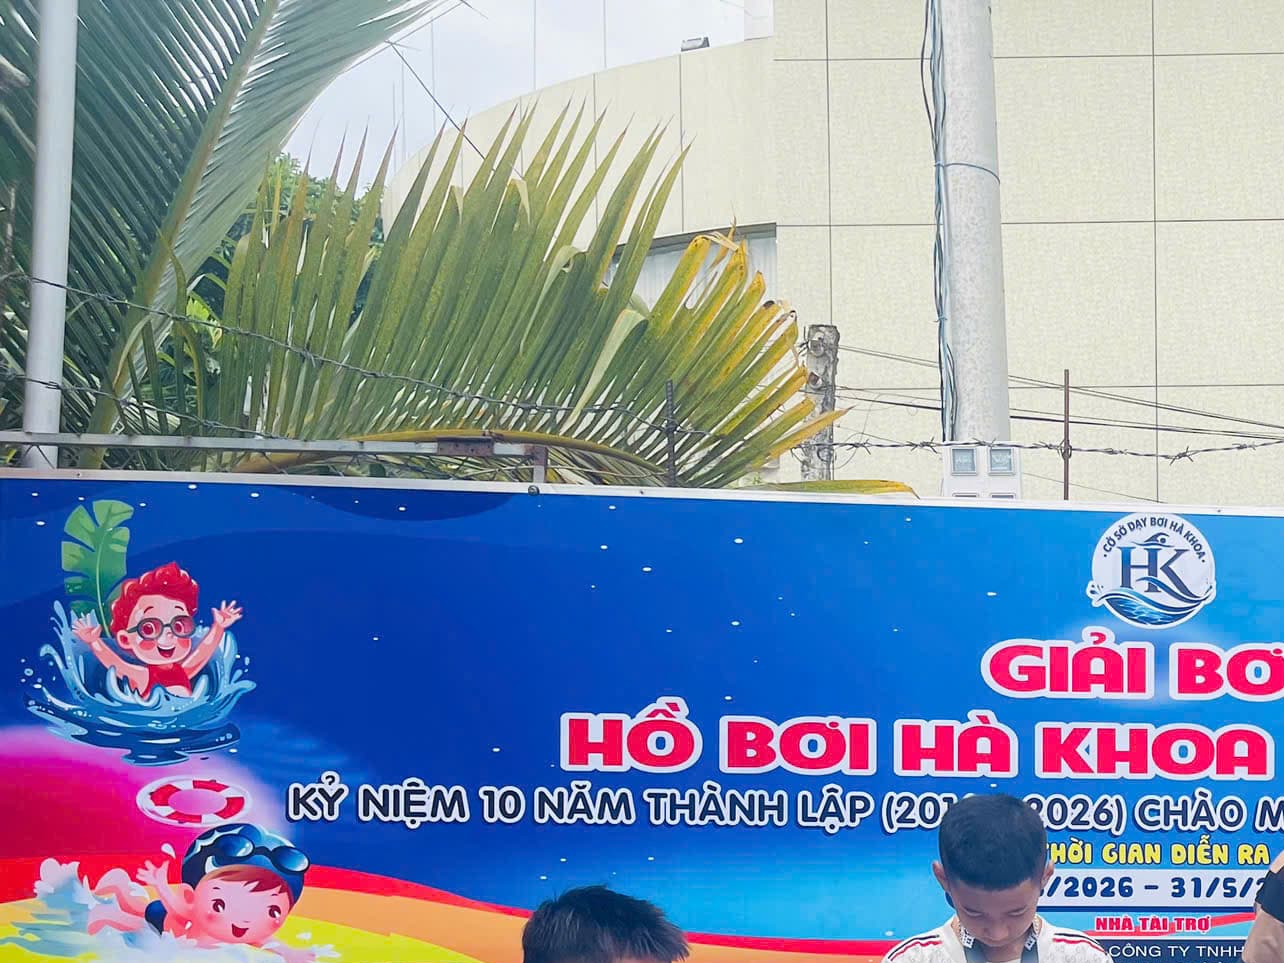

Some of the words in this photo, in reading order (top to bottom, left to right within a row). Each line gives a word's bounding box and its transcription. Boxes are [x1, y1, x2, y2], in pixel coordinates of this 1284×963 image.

[1127, 517, 1147, 531] DẠY
[1150, 517, 1168, 528] BƠI
[1183, 530, 1206, 559] KHOA
[986, 630, 1149, 695] GIẢI
[566, 700, 697, 769] HỒ
[725, 719, 872, 772] BƠI
[899, 713, 1013, 774] HÀ
[1040, 725, 1270, 777] KHOA
[291, 772, 347, 818] KỶ
[361, 779, 468, 826] NIỆM
[481, 787, 523, 820] 10
[536, 782, 634, 822] NĂM
[647, 782, 785, 823] THÀNH
[800, 785, 872, 831] LẬP
[1136, 789, 1245, 829] CHÀO
[1046, 836, 1093, 865] HỜI
[1101, 842, 1162, 866] GIAN
[1170, 834, 1228, 866] DIỄN
[1237, 843, 1272, 865] RA
[1041, 876, 1134, 898] /2026
[1095, 914, 1133, 931] NHÀ
[1138, 914, 1169, 931] TÀI
[1174, 914, 1210, 934] TRỢ
[1108, 942, 1161, 957] CÔNG
[1167, 945, 1191, 957] TY
[1195, 945, 1245, 958] TNHH
